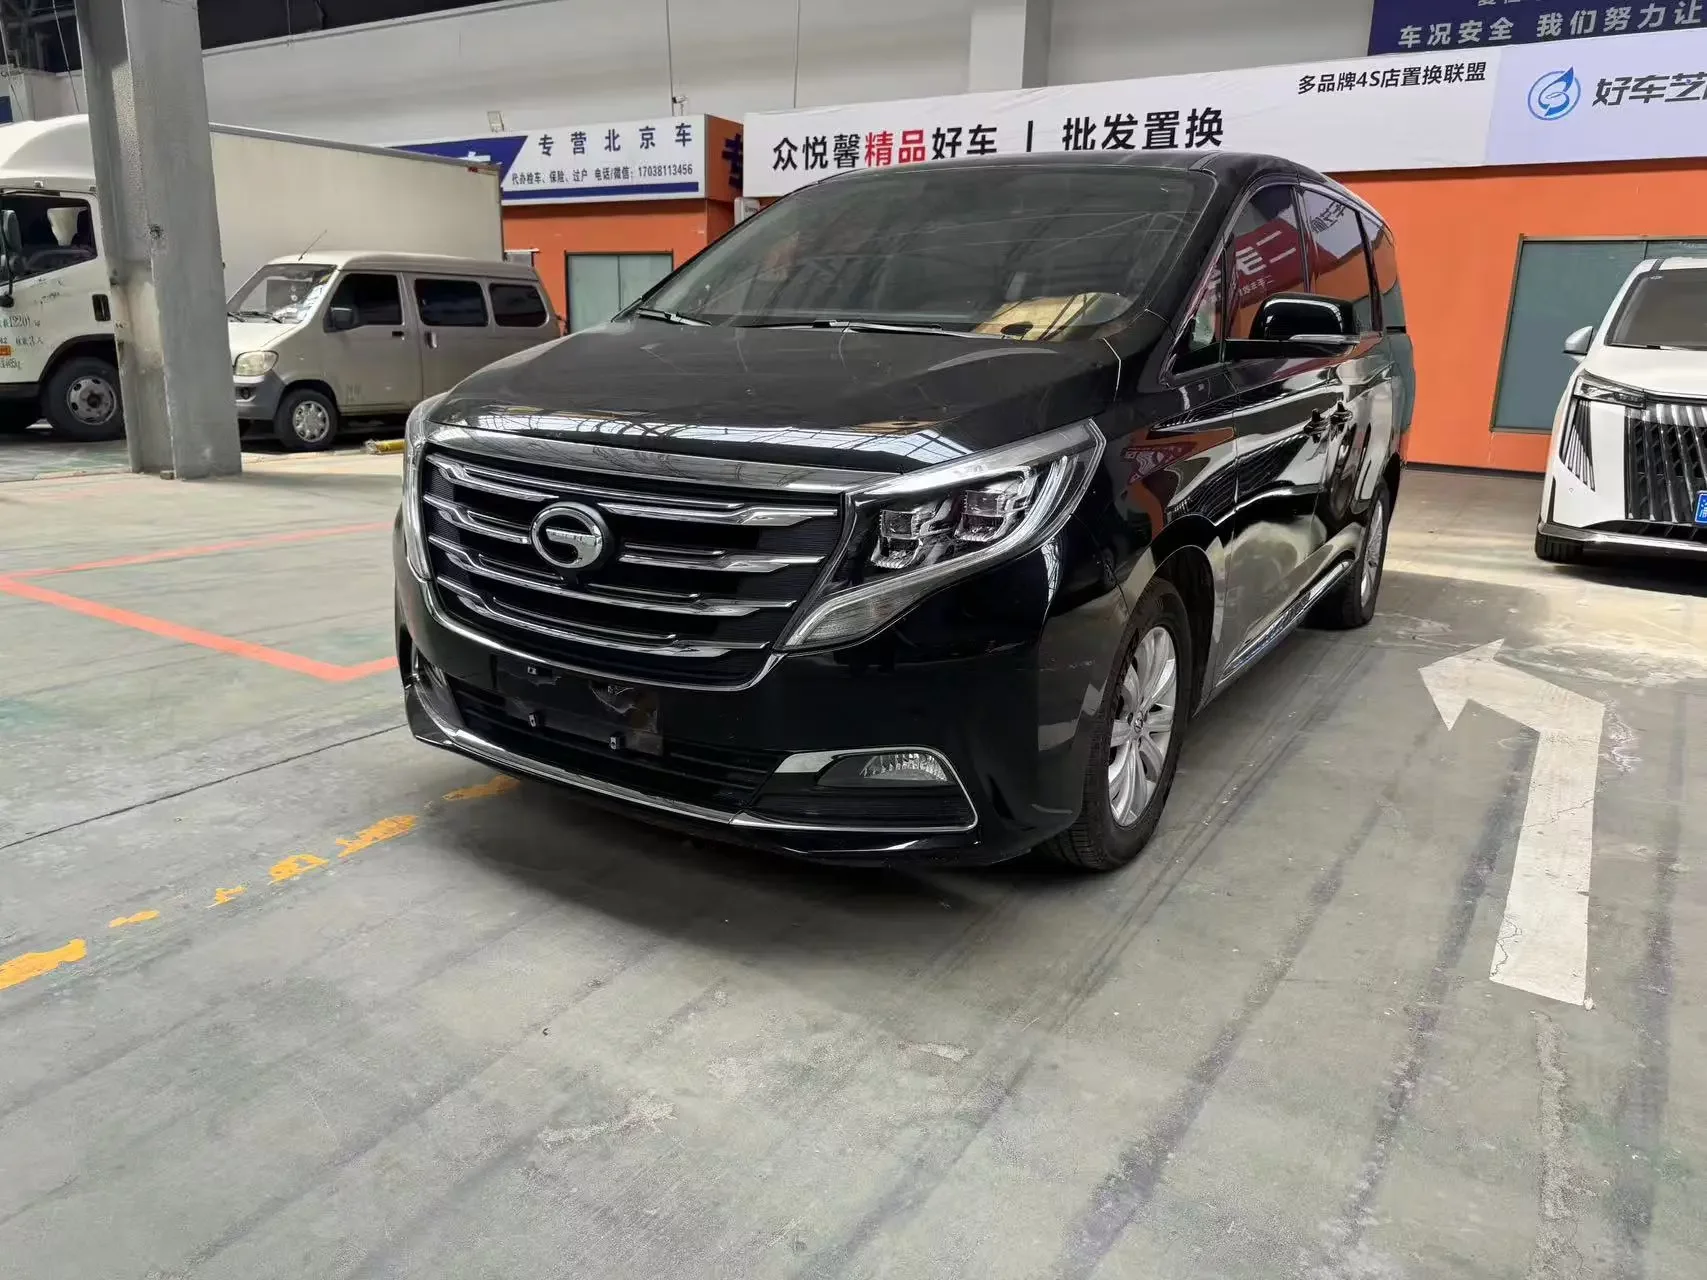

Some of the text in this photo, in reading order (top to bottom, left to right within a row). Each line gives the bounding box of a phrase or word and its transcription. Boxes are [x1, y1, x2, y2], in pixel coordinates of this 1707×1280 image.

[1398, 1, 1703, 48] 车况安全 我们努力让
[1298, 62, 1486, 94] 多品牌4S店置换联盟
[1592, 72, 1707, 107] 好车艺
[538, 122, 692, 156] 专营北京车
[773, 124, 998, 171] 众悦馨精品好车
[1062, 107, 1223, 151] 批发置换
